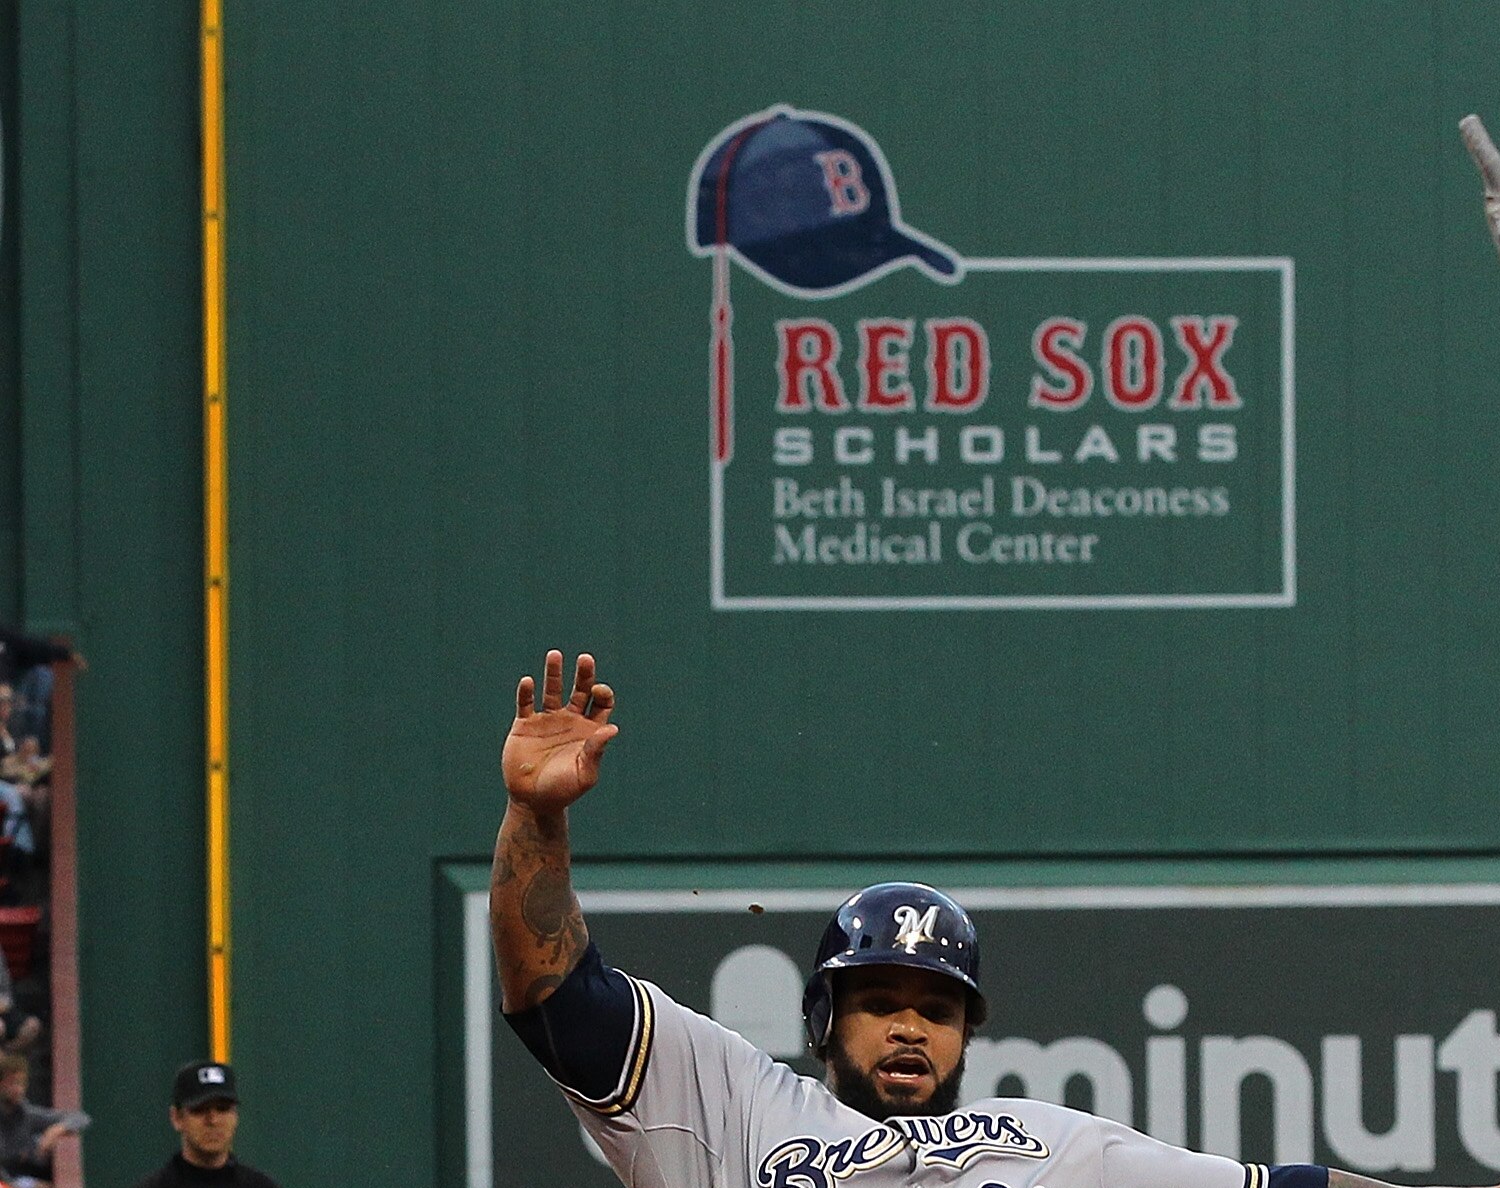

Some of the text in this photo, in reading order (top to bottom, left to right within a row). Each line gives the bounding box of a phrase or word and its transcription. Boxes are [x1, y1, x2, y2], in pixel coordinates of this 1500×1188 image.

[776, 315, 1242, 412] RED SOX
[774, 424, 1238, 464] SCHOLARS
[773, 476, 1230, 518] Beth Israel Deaconess
[773, 522, 1100, 565] Medical Center
[893, 905, 939, 951] M
